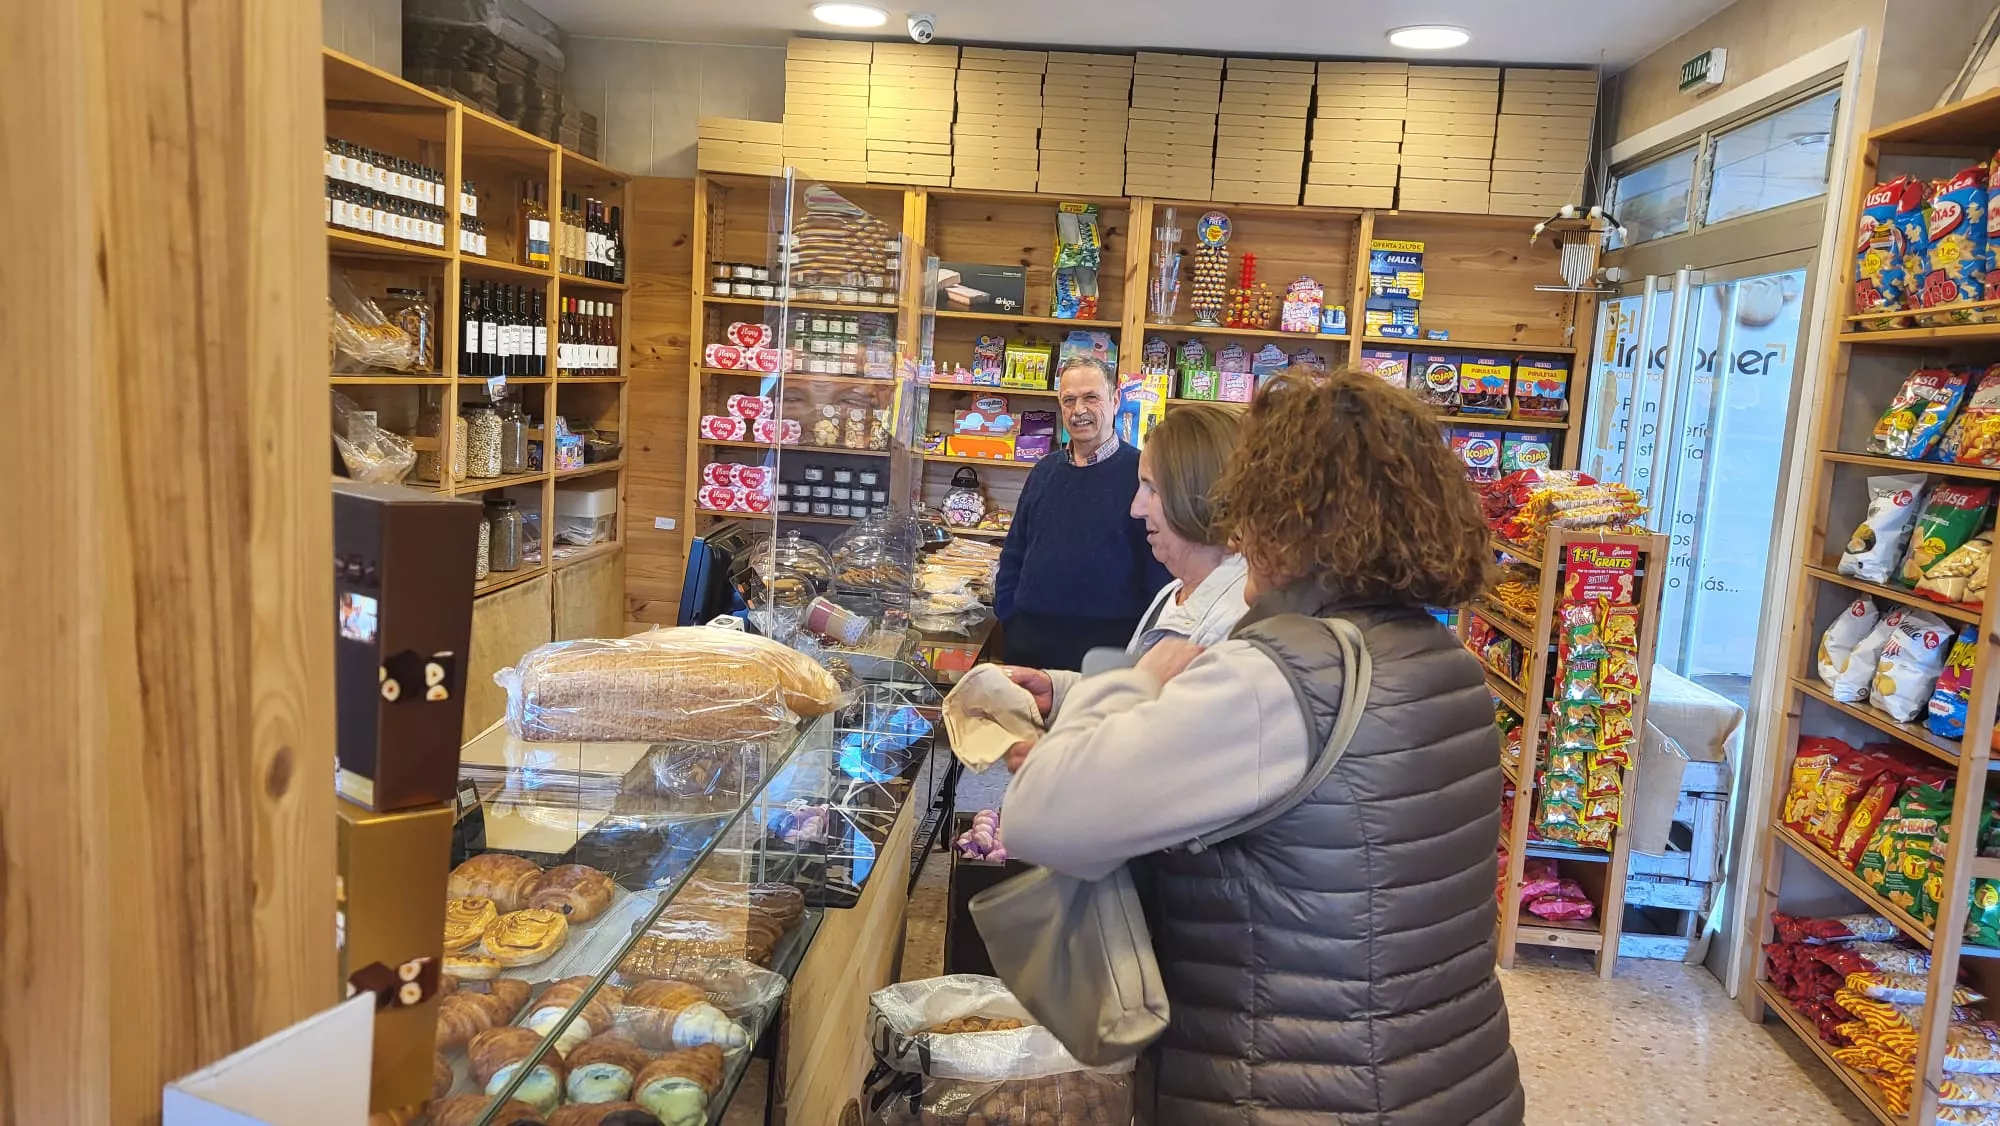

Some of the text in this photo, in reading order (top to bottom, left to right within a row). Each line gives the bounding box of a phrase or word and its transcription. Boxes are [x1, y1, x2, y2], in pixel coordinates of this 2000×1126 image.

[1680, 56, 1707, 85] SALIDA
[1372, 241, 1397, 250] OFERTA
[1387, 255, 1416, 264] HALLS
[741, 327, 759, 337] Happy
[744, 336, 755, 344] day
[718, 349, 737, 359] Happy
[721, 358, 732, 366] day
[1375, 362, 1404, 377] KOJAK
[1428, 370, 1456, 382] KOJAK
[740, 399, 759, 409] Happy
[744, 408, 755, 416] day
[713, 420, 732, 430] Happy
[717, 428, 728, 437] day
[1466, 447, 1495, 459] KOJAK
[1519, 451, 1547, 462] KOJAK
[715, 467, 729, 476] Happ
[742, 470, 761, 480] Happy
[746, 478, 757, 486] day
[712, 491, 731, 500] Happy
[750, 491, 768, 502] Happy
[716, 498, 727, 506] day
[752, 500, 764, 509] day
[1572, 546, 1598, 563] 1+1
[1595, 558, 1632, 567] GRATIS
